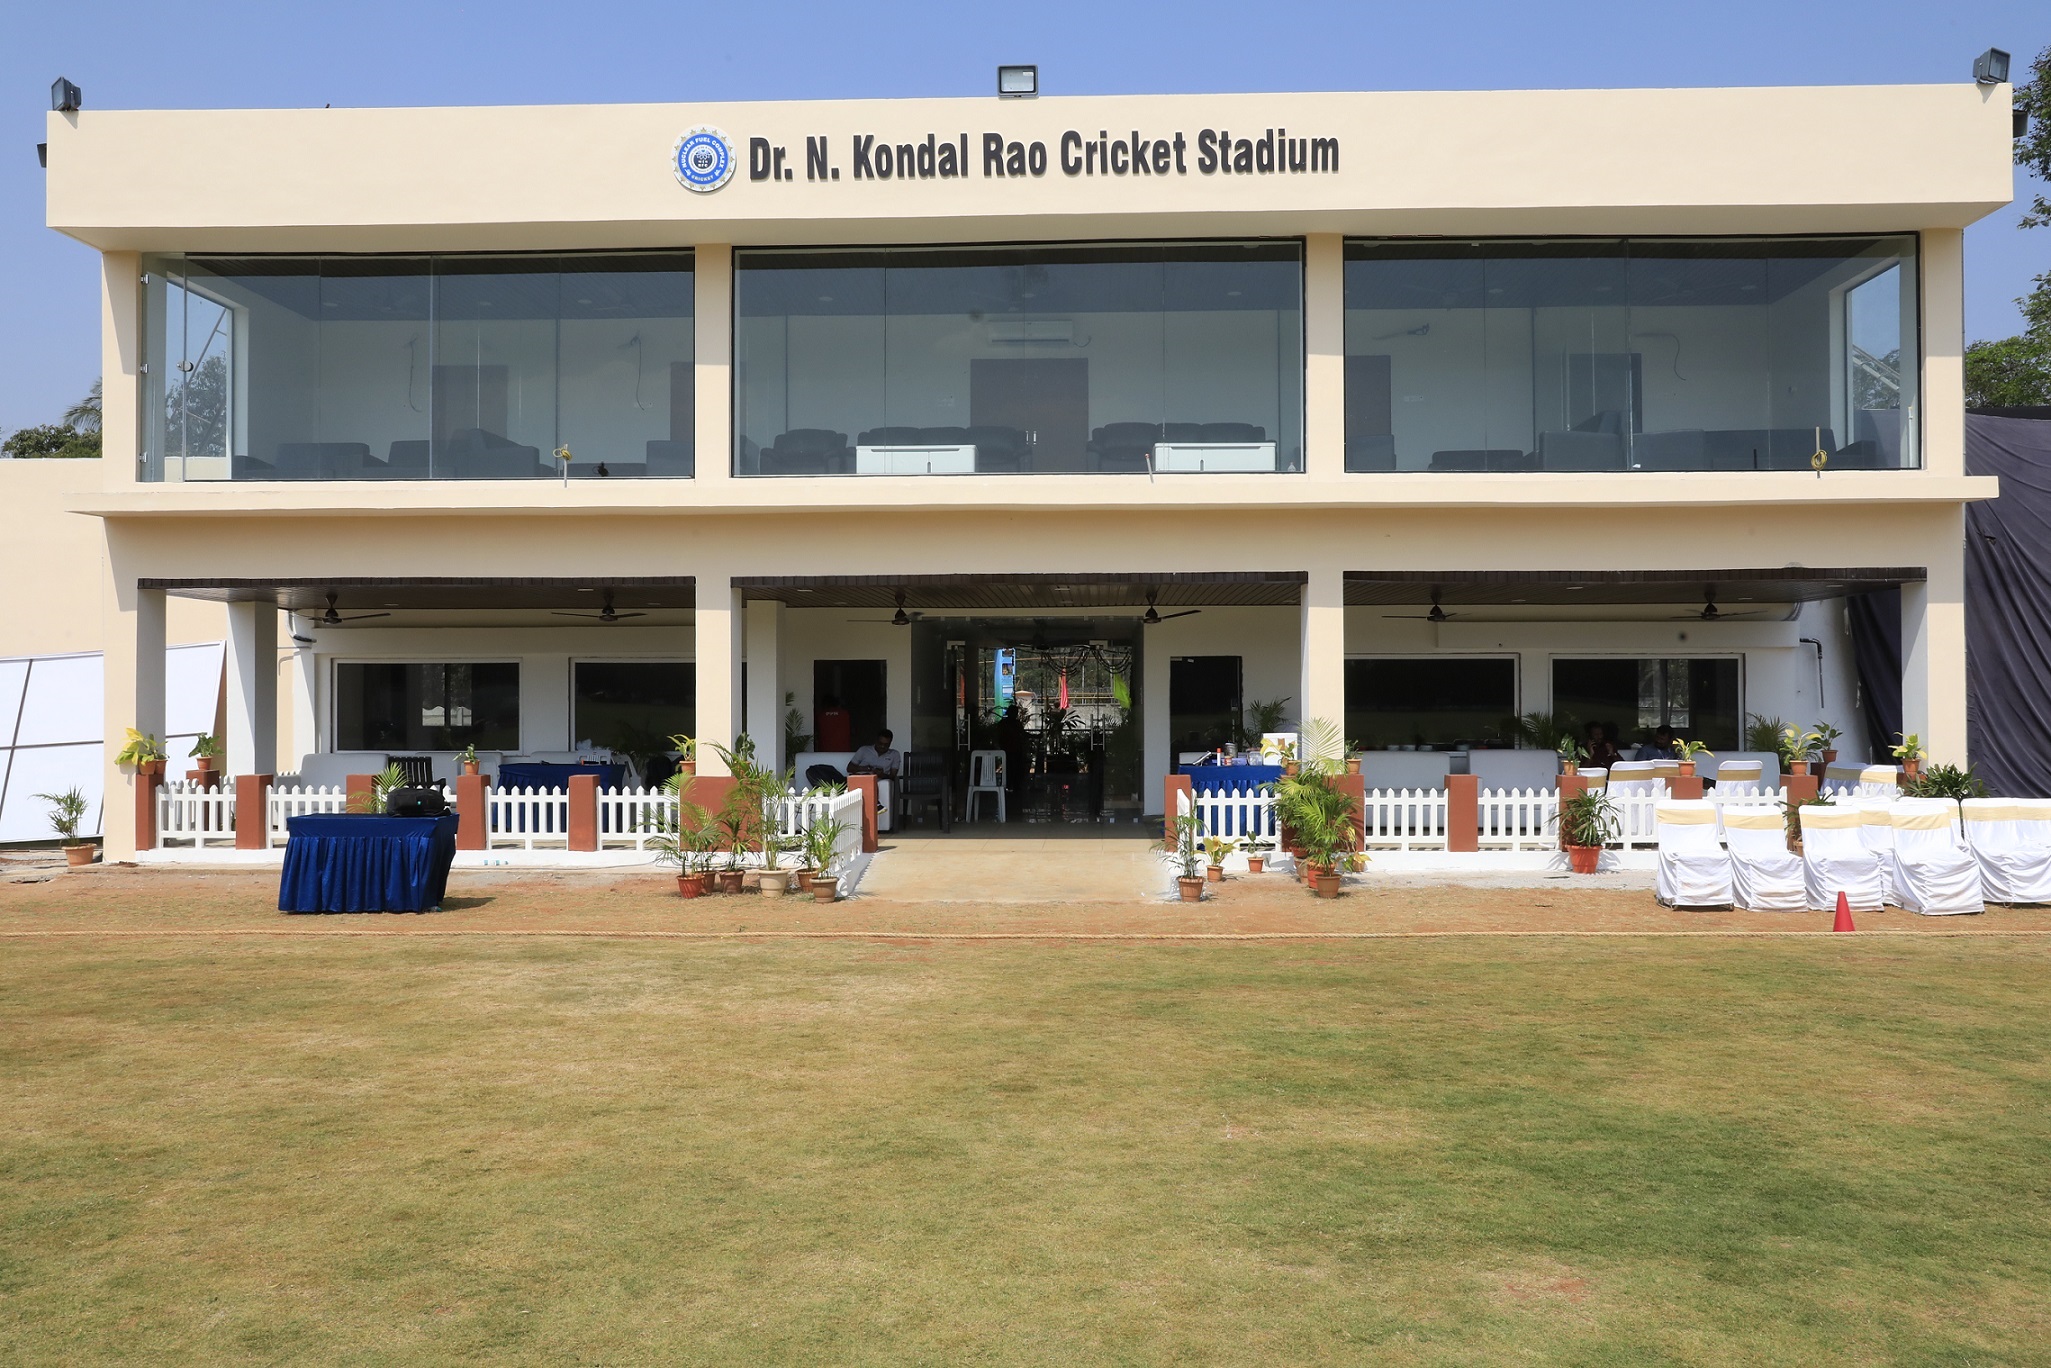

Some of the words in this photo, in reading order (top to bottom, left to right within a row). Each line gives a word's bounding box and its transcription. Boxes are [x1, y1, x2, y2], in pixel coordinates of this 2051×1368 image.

[681, 140, 695, 168] NUCLEAR
[711, 140, 725, 168] COMPLEX
[749, 137, 793, 180] Dr.
[806, 136, 840, 180] N.
[853, 134, 968, 179] Kondal
[982, 132, 1047, 177] Rao
[1060, 130, 1187, 176] Cricket
[1197, 128, 1339, 174] Stadium
